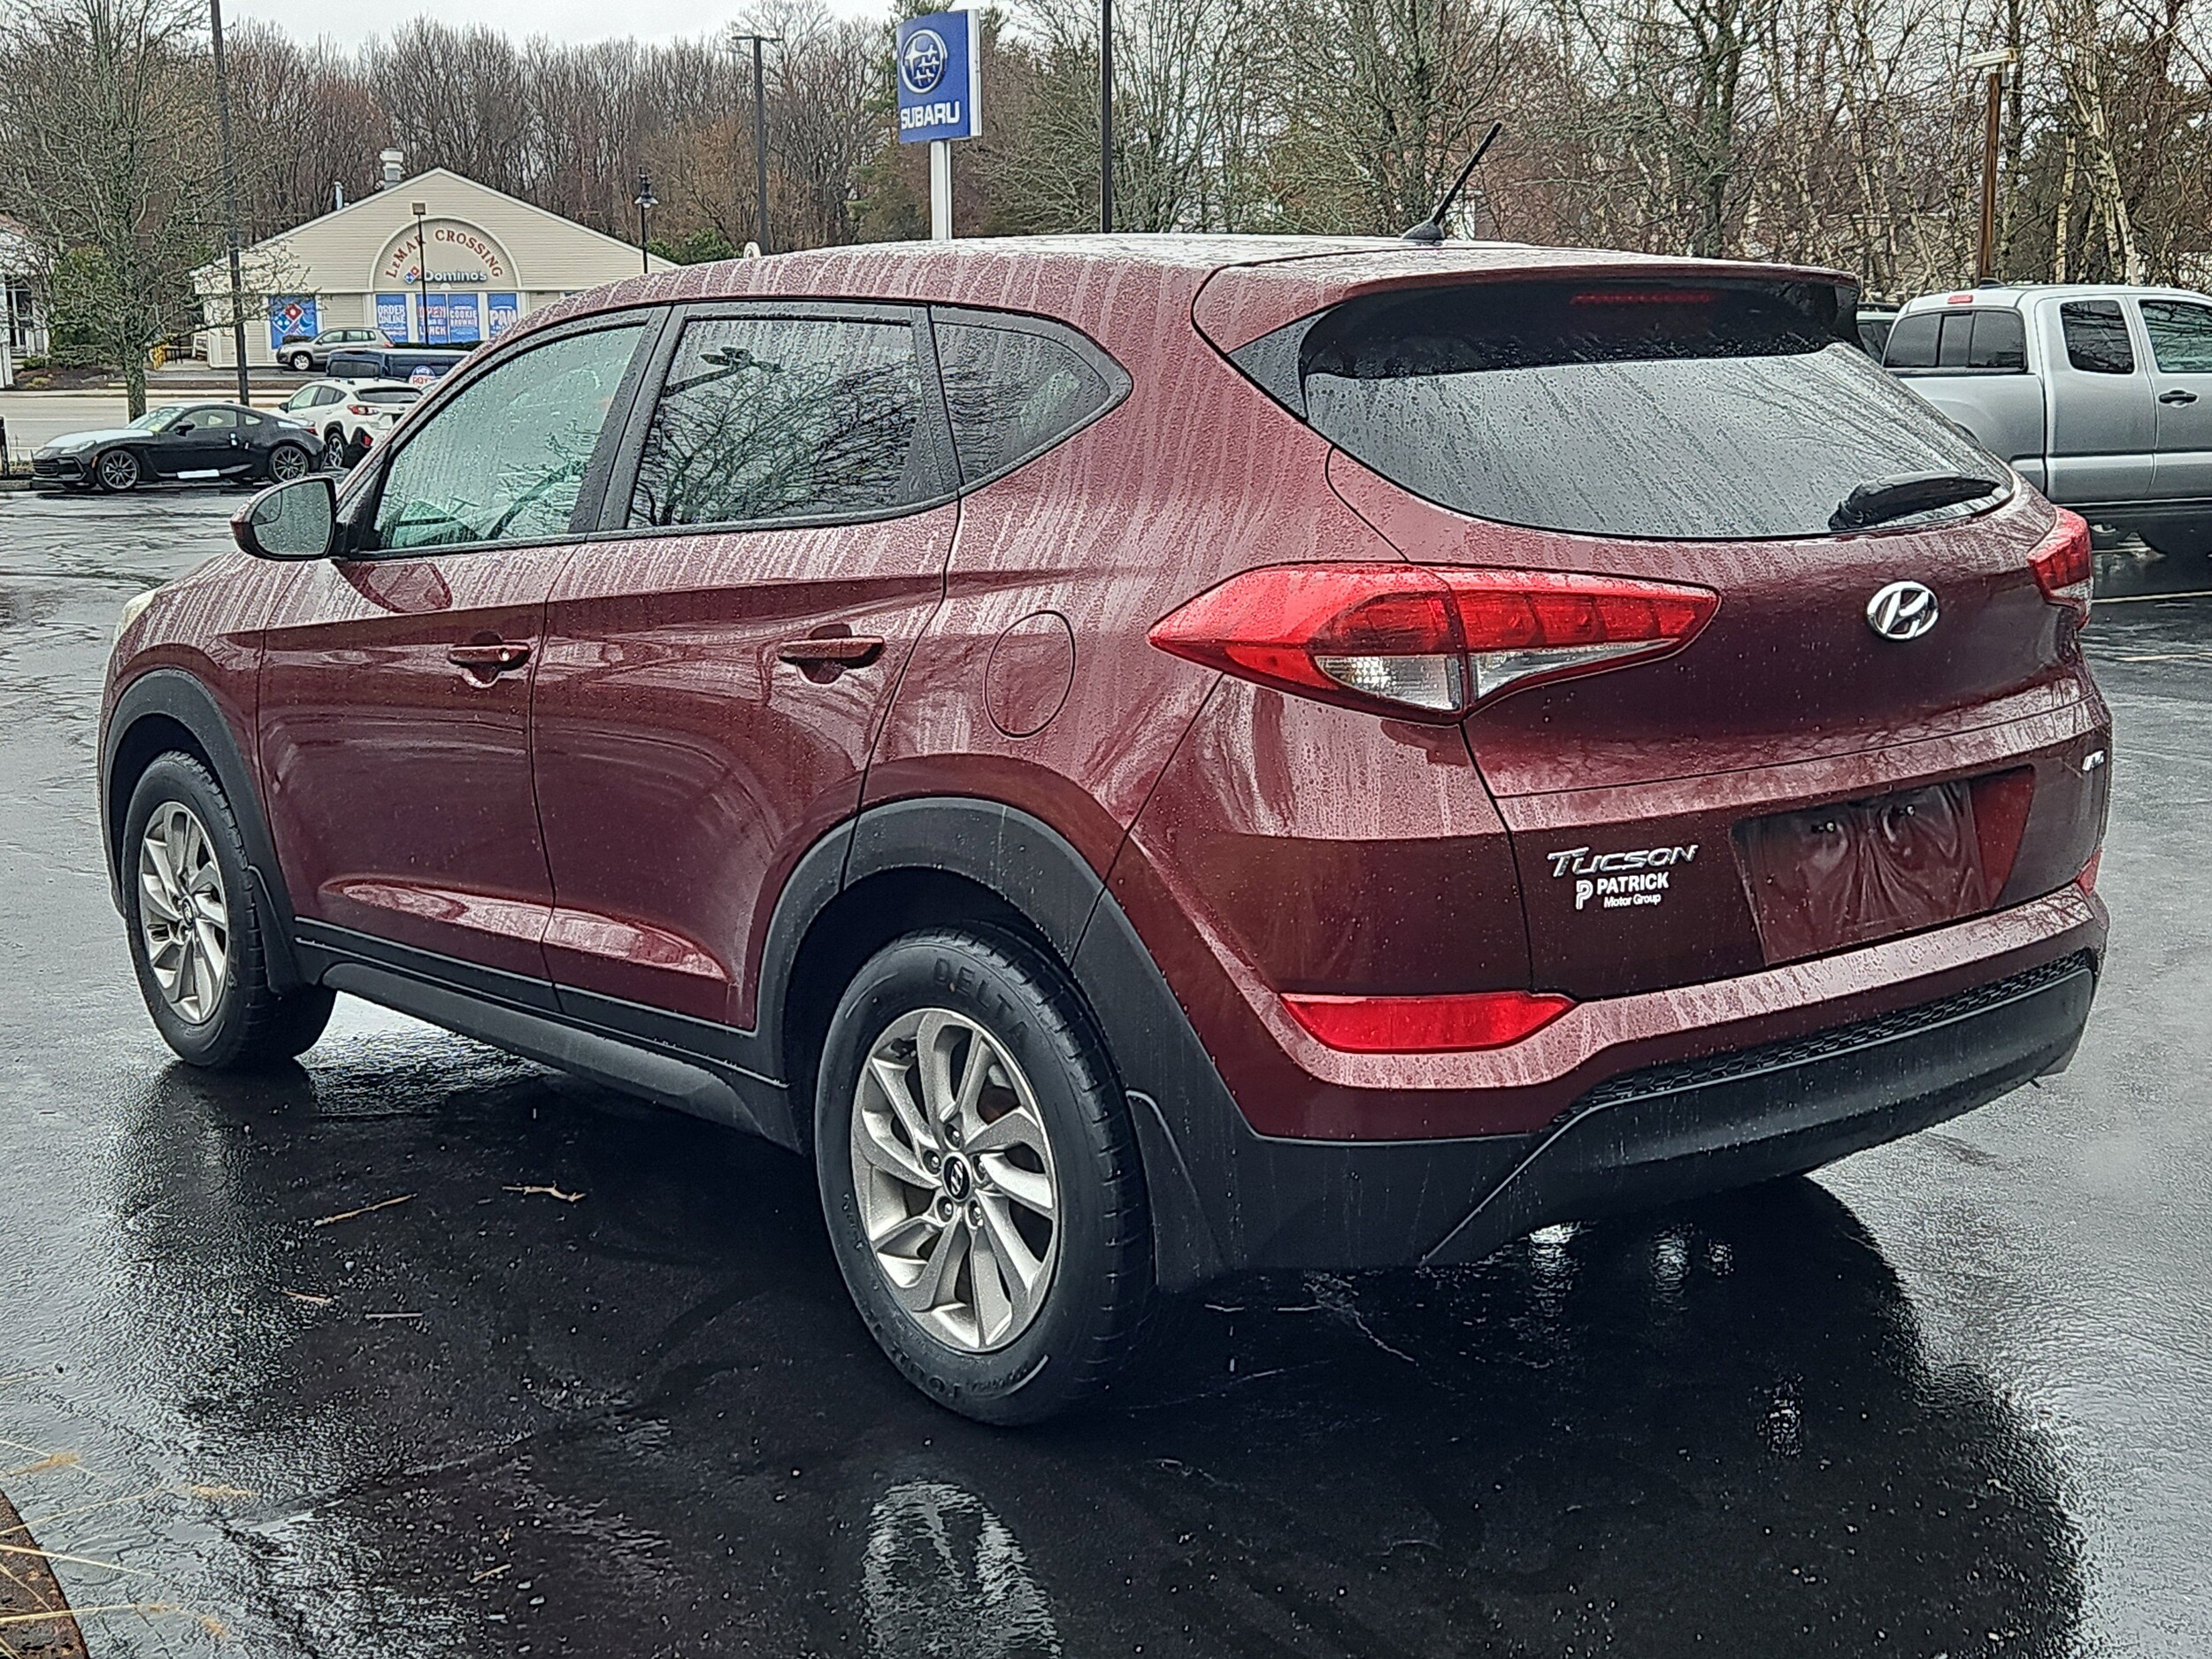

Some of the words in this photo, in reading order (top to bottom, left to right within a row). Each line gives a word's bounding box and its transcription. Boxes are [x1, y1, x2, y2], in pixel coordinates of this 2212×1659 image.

[901, 101, 960, 130] SUBARU
[434, 229, 503, 278] CROSSING
[425, 270, 487, 282] Domino's
[378, 304, 405, 314] ORDER
[449, 310, 477, 319] COOKIE
[489, 310, 517, 327] PAN
[1547, 844, 1699, 878] TUCSON
[1596, 871, 1669, 895] PATRICK
[1603, 895, 1632, 909] Motor
[1633, 893, 1662, 907] Group
